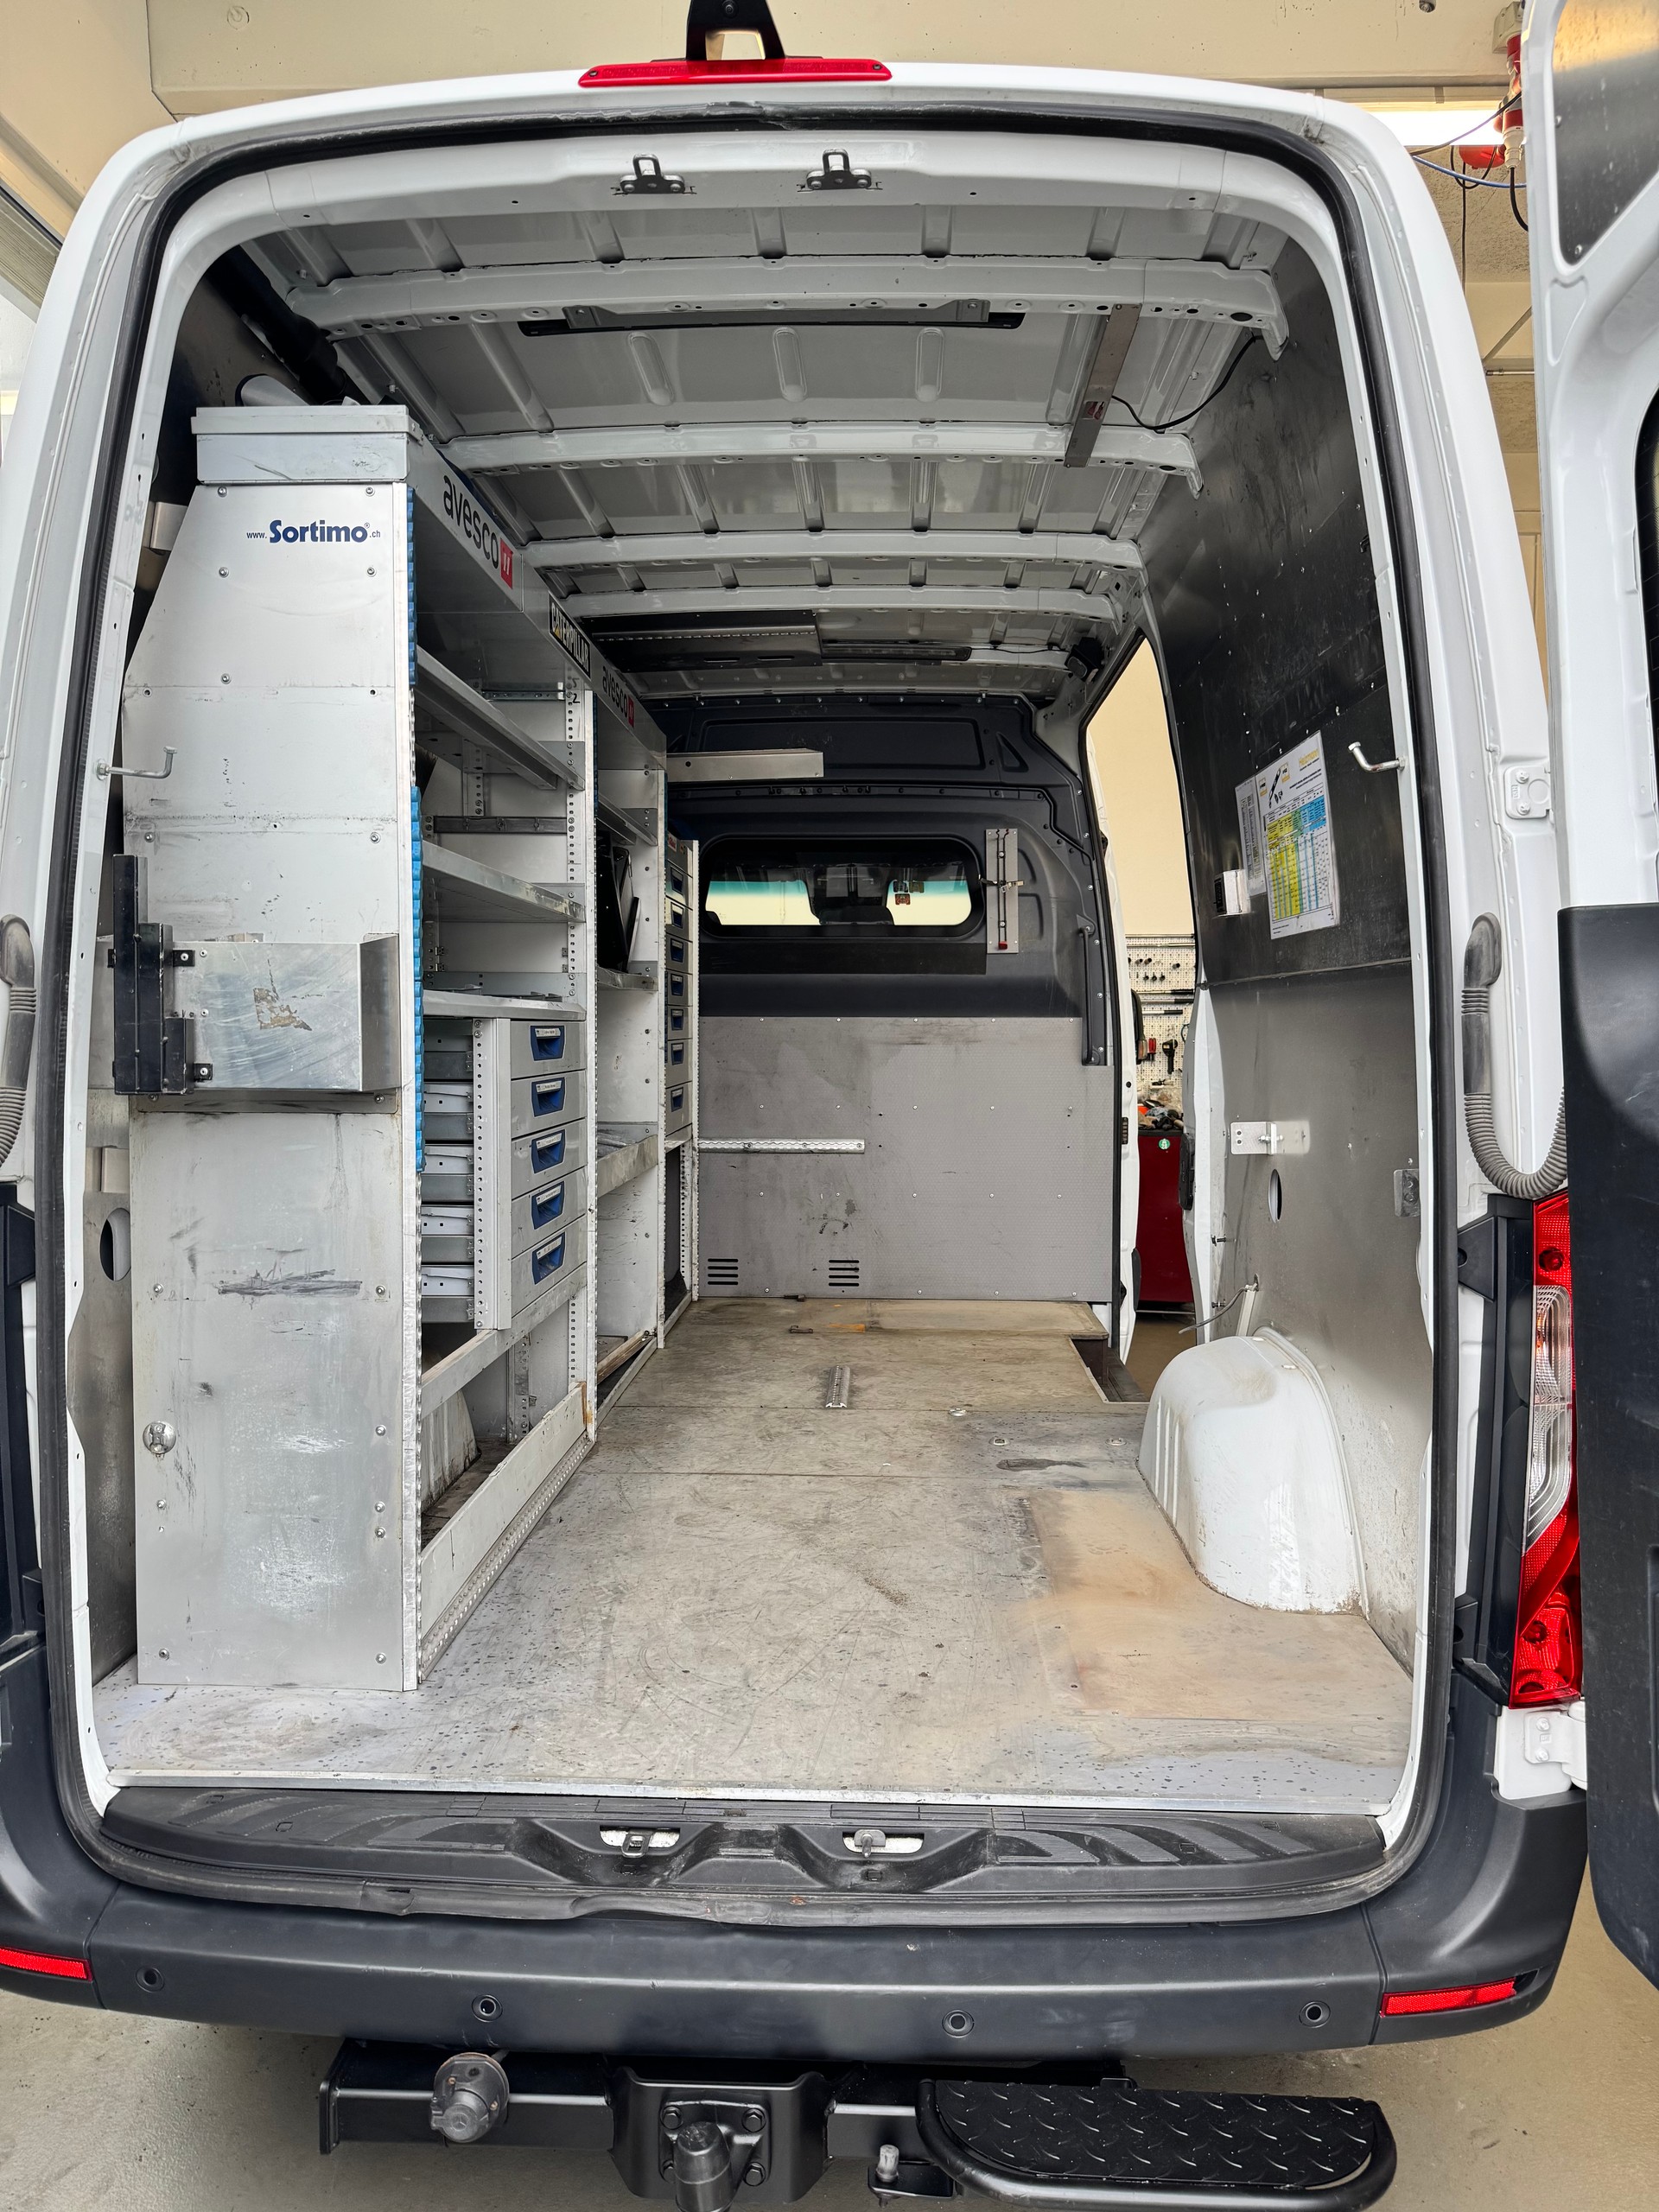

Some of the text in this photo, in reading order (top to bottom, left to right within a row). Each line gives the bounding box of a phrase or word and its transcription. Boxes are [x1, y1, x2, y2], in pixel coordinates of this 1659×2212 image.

[443, 475, 499, 569] avesco
[551, 602, 589, 673] CATERPILLAR
[602, 666, 629, 718] avesco
